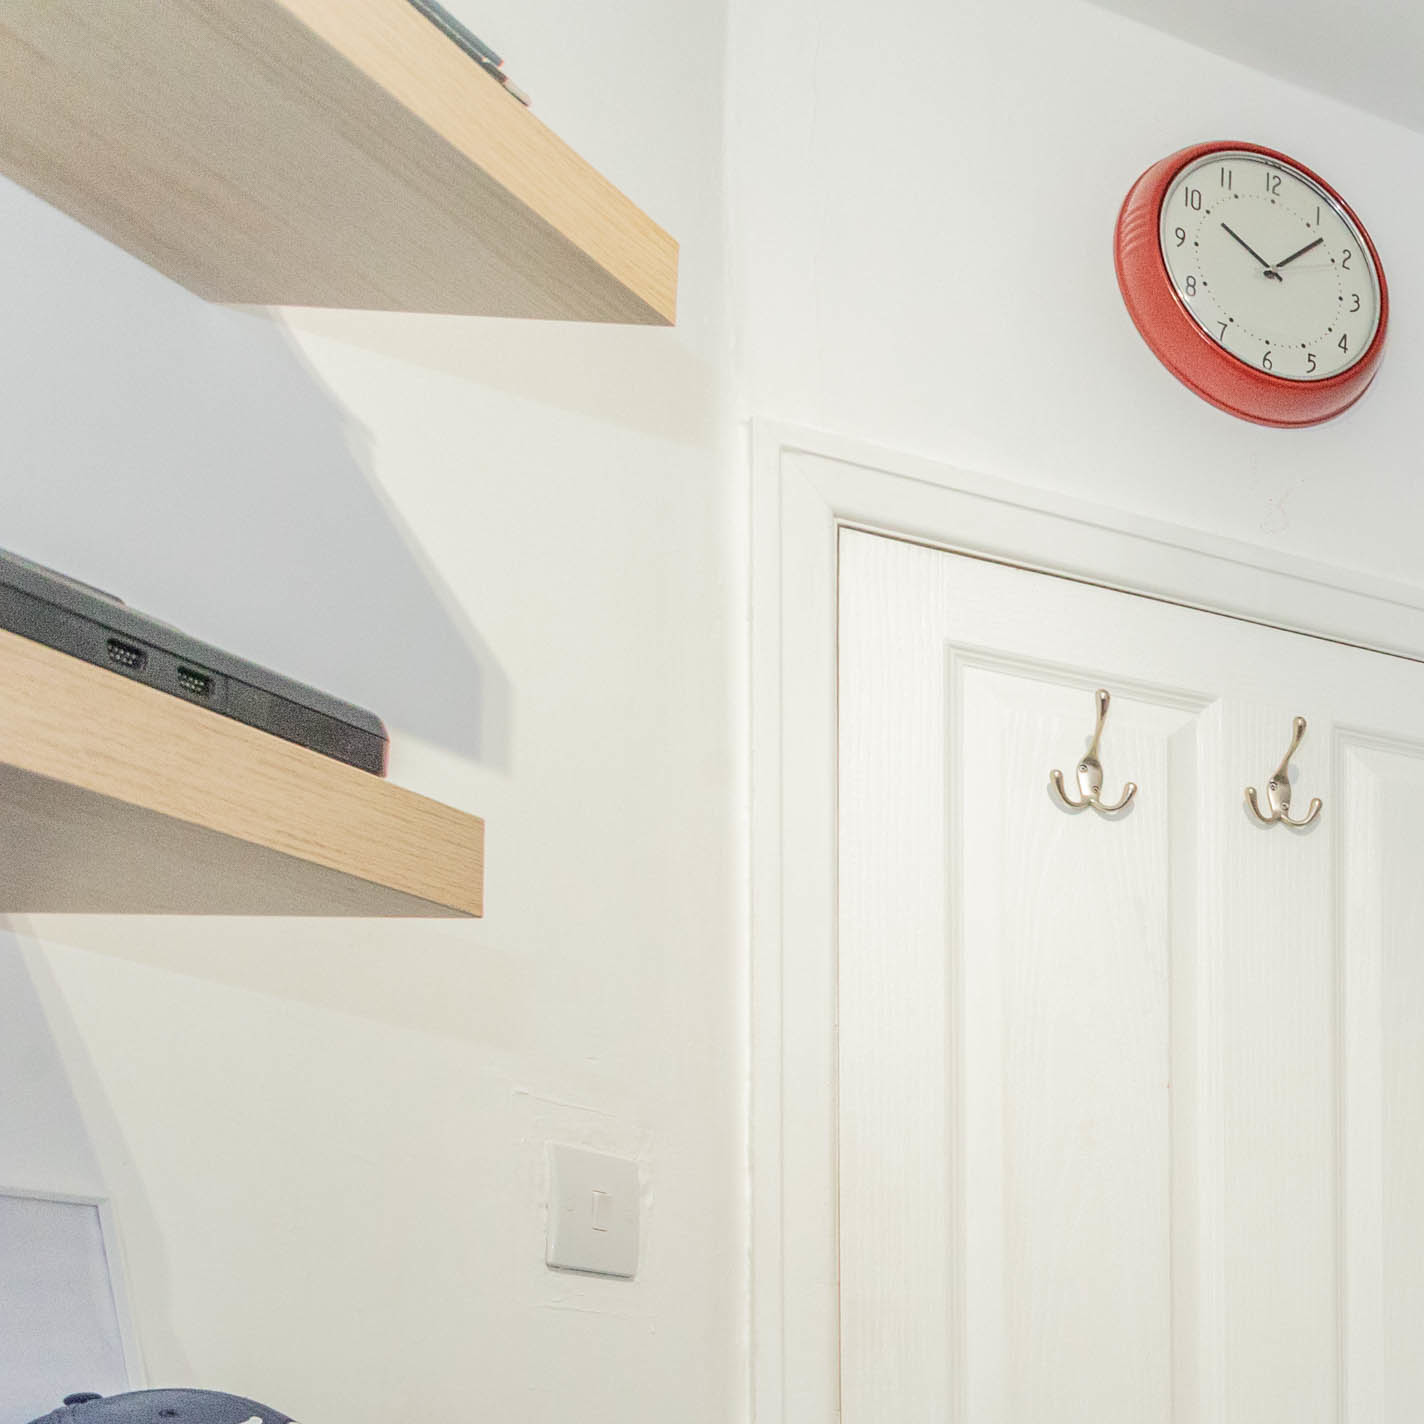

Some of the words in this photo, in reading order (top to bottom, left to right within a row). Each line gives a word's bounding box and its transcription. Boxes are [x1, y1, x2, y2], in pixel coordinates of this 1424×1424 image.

[1220, 167, 1232, 190] 11
[1266, 172, 1282, 196] 12
[1185, 187, 1201, 210] 10
[1315, 206, 1321, 225] 1
[1175, 227, 1186, 247] 9
[1342, 249, 1351, 270] 2
[1185, 275, 1196, 296] 8
[1350, 294, 1360, 312] 3
[1217, 321, 1228, 340] 7
[1337, 333, 1348, 353] 4
[1262, 351, 1273, 370] 6
[1306, 353, 1316, 373] 5
